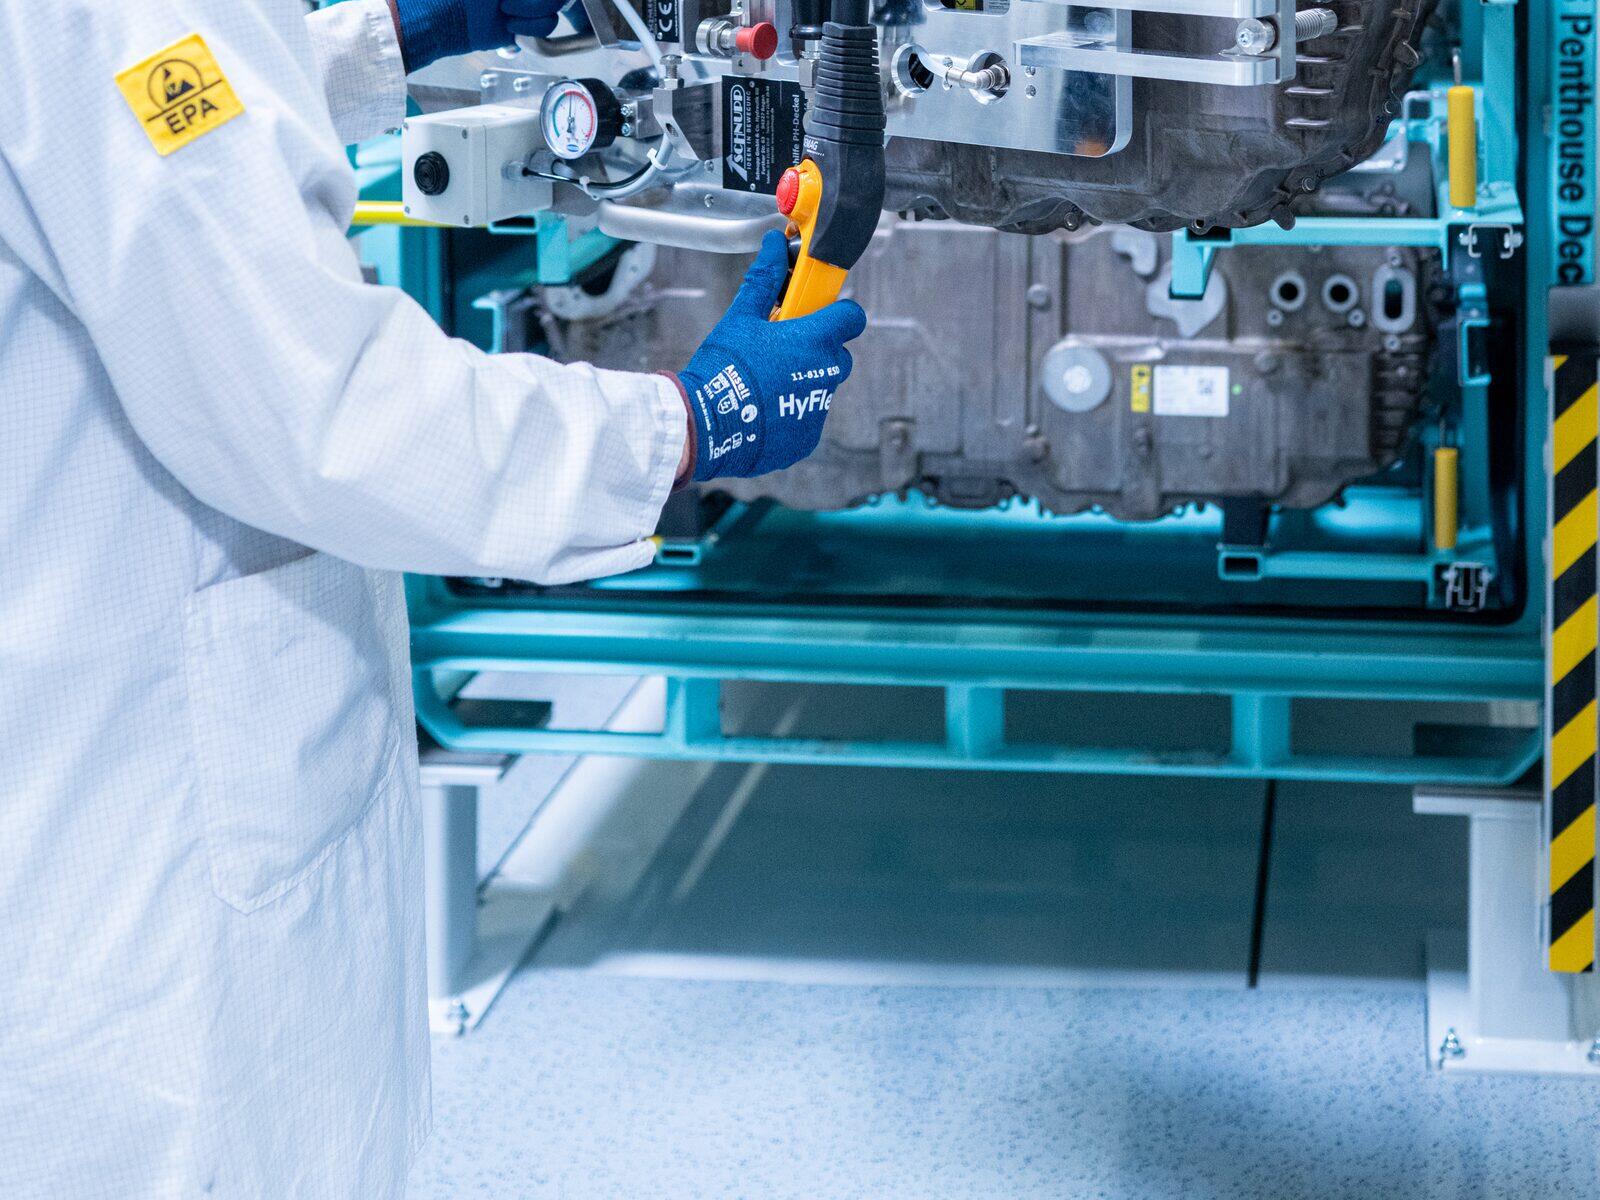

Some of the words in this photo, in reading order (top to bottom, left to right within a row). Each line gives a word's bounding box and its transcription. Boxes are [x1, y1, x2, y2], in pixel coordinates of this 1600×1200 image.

[658, 1, 673, 32] CE
[165, 98, 218, 135] EPA
[792, 94, 800, 141] PH-Deckel
[1559, 13, 1592, 202] Penthouse
[733, 89, 745, 163] SCHNUPP
[792, 143, 800, 167] hilfe
[725, 364, 751, 400] Ansell
[791, 368, 825, 381] 11-819
[826, 365, 840, 377] ESD
